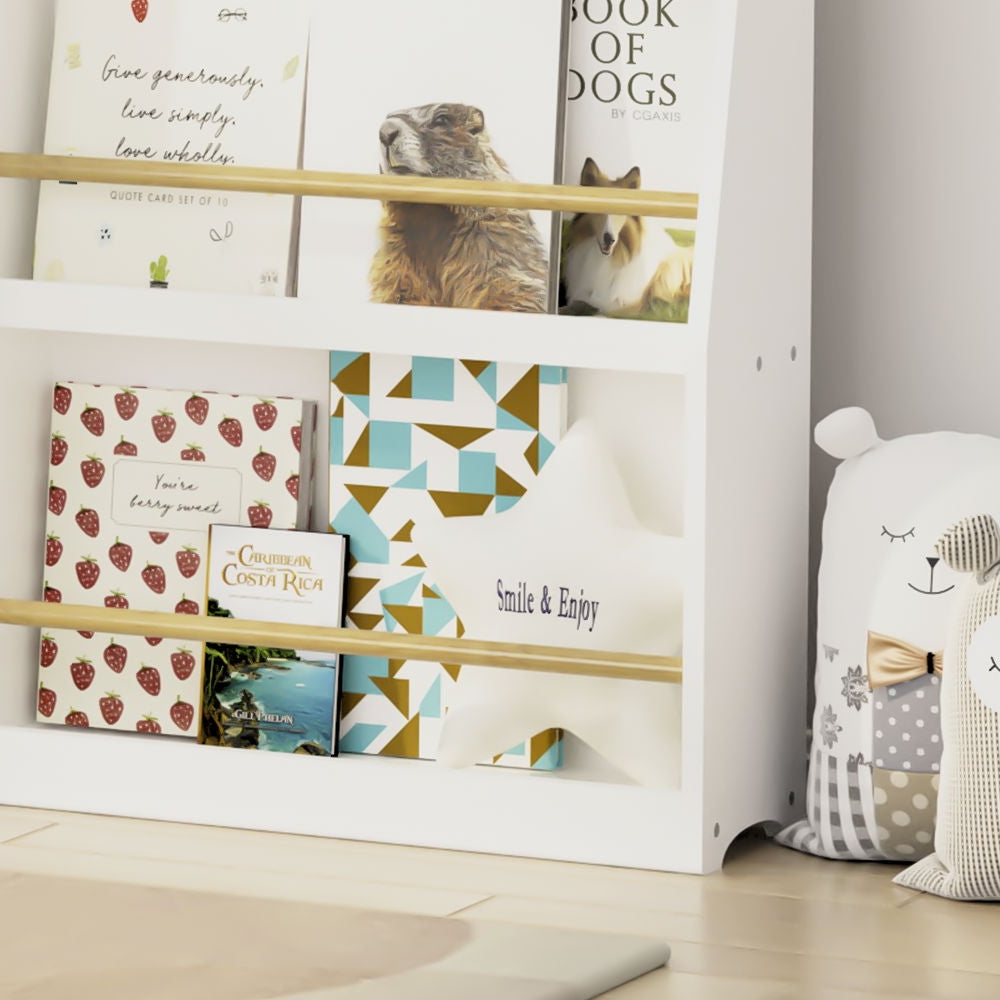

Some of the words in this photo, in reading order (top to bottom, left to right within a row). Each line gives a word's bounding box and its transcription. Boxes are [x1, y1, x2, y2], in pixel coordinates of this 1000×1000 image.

[590, 30, 645, 65] OF
[101, 54, 148, 82] Give
[151, 65, 264, 101] generously.
[121, 97, 163, 120] live
[167, 103, 236, 139] simply.
[610, 108, 627, 120] BY
[632, 110, 682, 122] CGAXIS
[114, 136, 158, 158] love
[109, 190, 144, 202] QUOTE
[147, 192, 174, 204] CARD
[178, 193, 195, 206] SET
[199, 195, 213, 207] OF
[217, 196, 229, 208] 10
[154, 473, 199, 491] You're
[129, 494, 174, 518] berry
[176, 501, 222, 514] sweet
[237, 543, 313, 570] CARIBBEAN
[221, 562, 277, 587] COSTA
[278, 568, 324, 598] RICA
[496, 578, 535, 614] Smile
[540, 584, 552, 615] &
[557, 586, 600, 633] Enjoy
